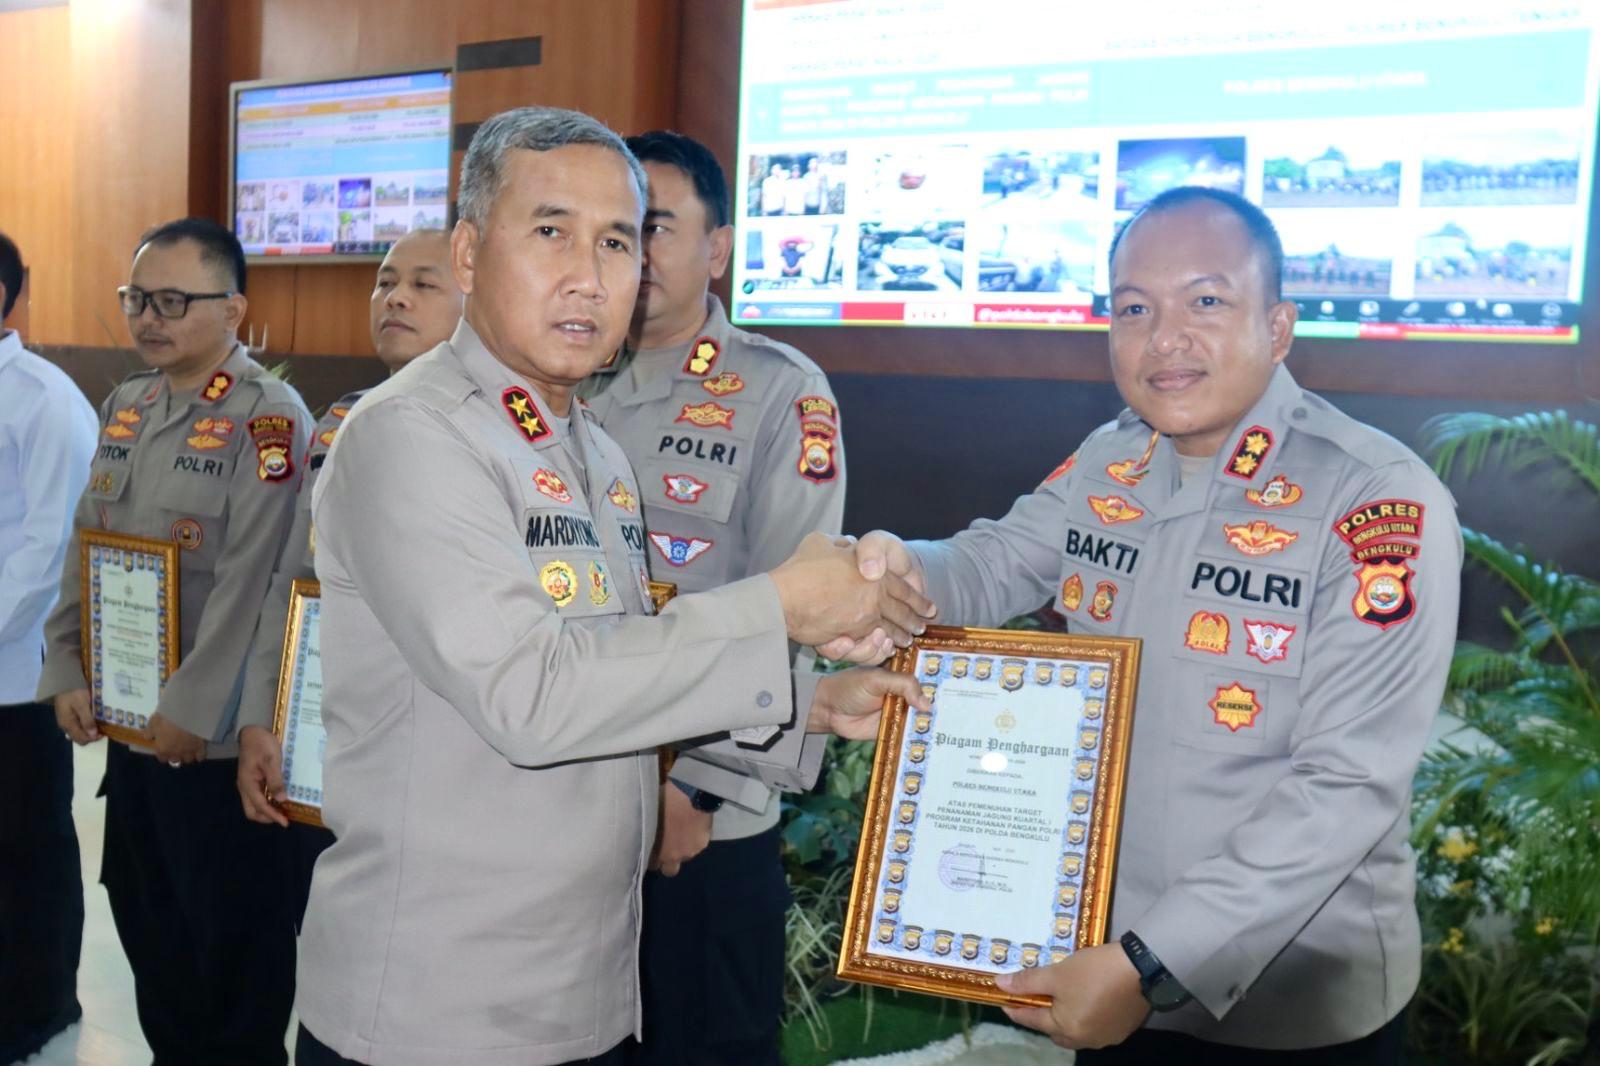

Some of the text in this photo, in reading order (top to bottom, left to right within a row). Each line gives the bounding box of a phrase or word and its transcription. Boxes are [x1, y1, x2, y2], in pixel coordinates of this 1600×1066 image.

[659, 435, 736, 465] POLRI
[174, 456, 223, 476] POLRI
[1339, 504, 1419, 534] POLRES
[1352, 522, 1415, 545] BENGKULU UTARA
[1066, 528, 1139, 574] BAKTI
[1356, 543, 1413, 560] BENGKULU
[1191, 561, 1302, 608] POLRI
[934, 732, 1070, 757] Piagam Penghargaan
[937, 806, 981, 817] PENANAMAN
[983, 812, 1012, 821] JAGUNG
[1013, 815, 1047, 825] KUARTAL
[968, 802, 1012, 812] PEMENUHAN
[1014, 807, 1042, 816] TARGET
[925, 812, 961, 822] PROGRAM
[962, 817, 1006, 828] KETAHANAN
[1007, 822, 1038, 832] PANGAN
[934, 821, 958, 830] TAHUN
[984, 828, 1008, 837] POLDA
[1010, 831, 1050, 842] BENGKULU
